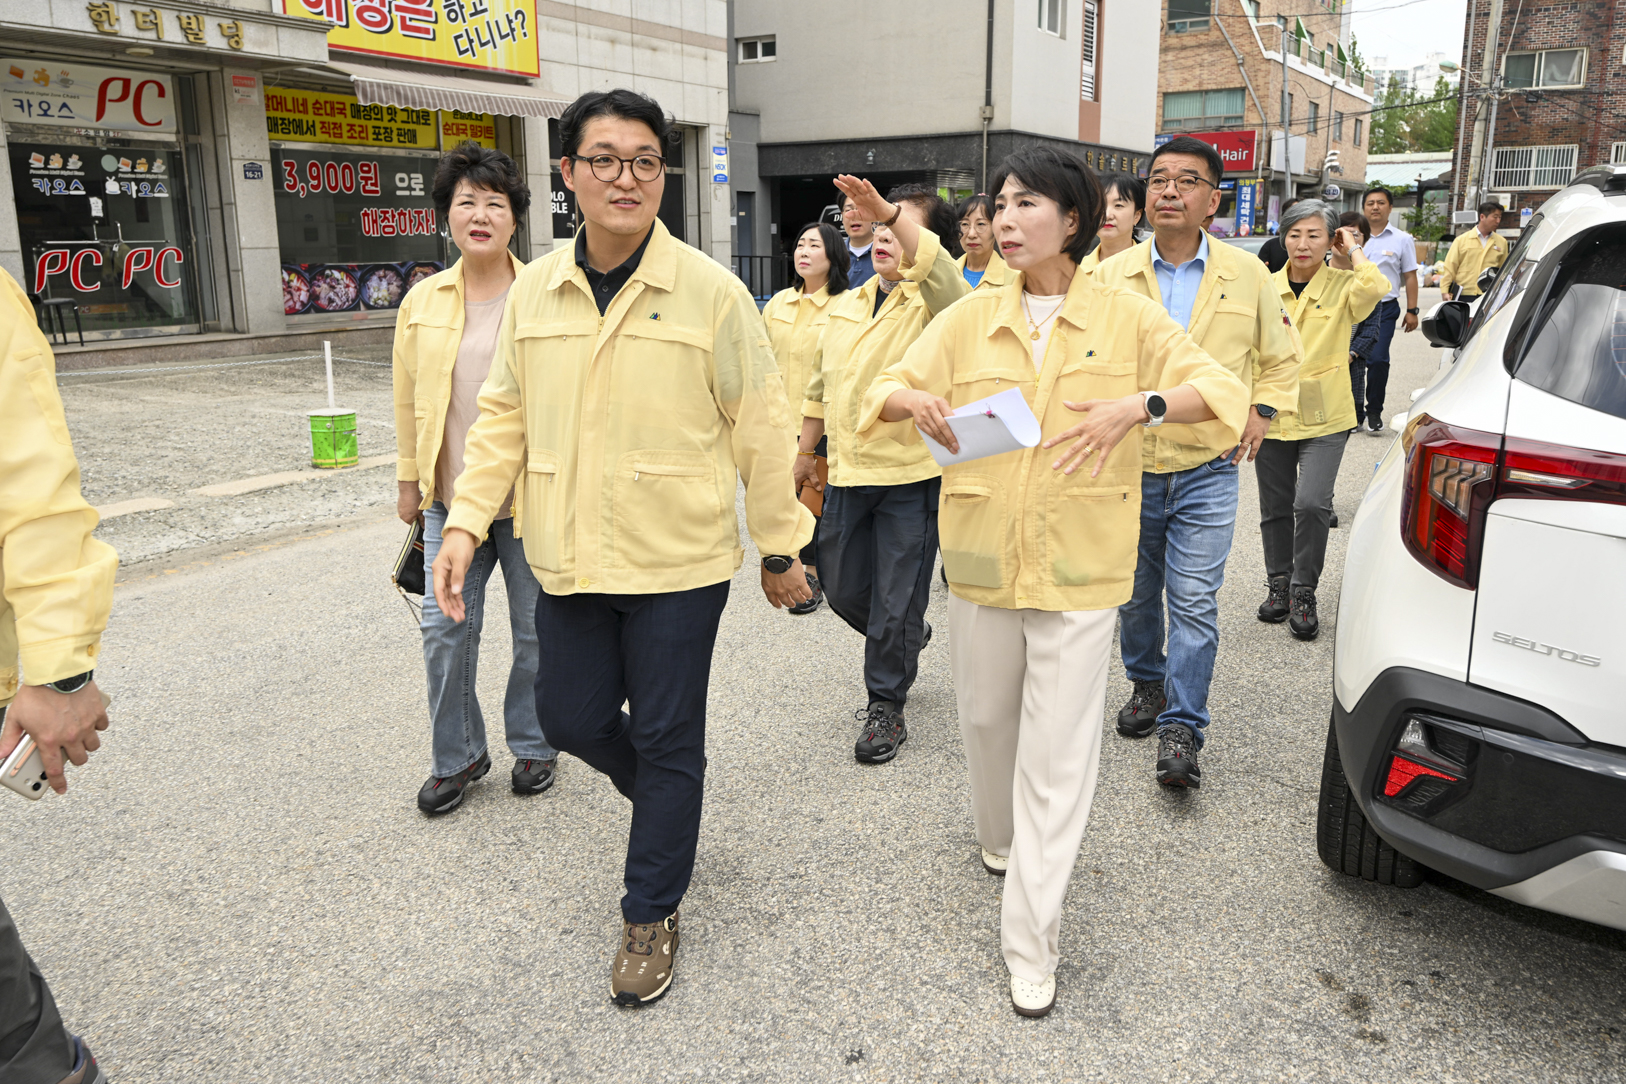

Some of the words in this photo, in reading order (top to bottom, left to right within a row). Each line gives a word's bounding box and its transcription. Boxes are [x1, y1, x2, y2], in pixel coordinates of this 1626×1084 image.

[87, 2, 245, 49] 한터빌딩
[453, 9, 528, 58] 다니냐?
[12, 98, 76, 119] 카오스
[95, 76, 167, 127] PC
[312, 99, 347, 119] 순대국
[350, 103, 384, 122] 매장의
[386, 107, 397, 124] 맛
[400, 108, 431, 126] 그대로
[266, 116, 316, 137] 매장에서
[319, 120, 343, 139] 직접
[346, 123, 369, 141] 조리
[371, 125, 394, 143] 포장
[396, 127, 417, 144] 판매
[443, 121, 468, 138] 순대국
[470, 124, 494, 139] 밀키트
[1221, 148, 1249, 161] Hair
[32, 178, 86, 196] 카오스
[121, 181, 169, 198] 카오스
[282, 160, 381, 198] 3,900원
[395, 172, 425, 196] 으로
[360, 207, 436, 237] 해장하자!
[35, 248, 103, 293] PC
[122, 246, 183, 289] PC
[1492, 630, 1601, 668] SELTOS
